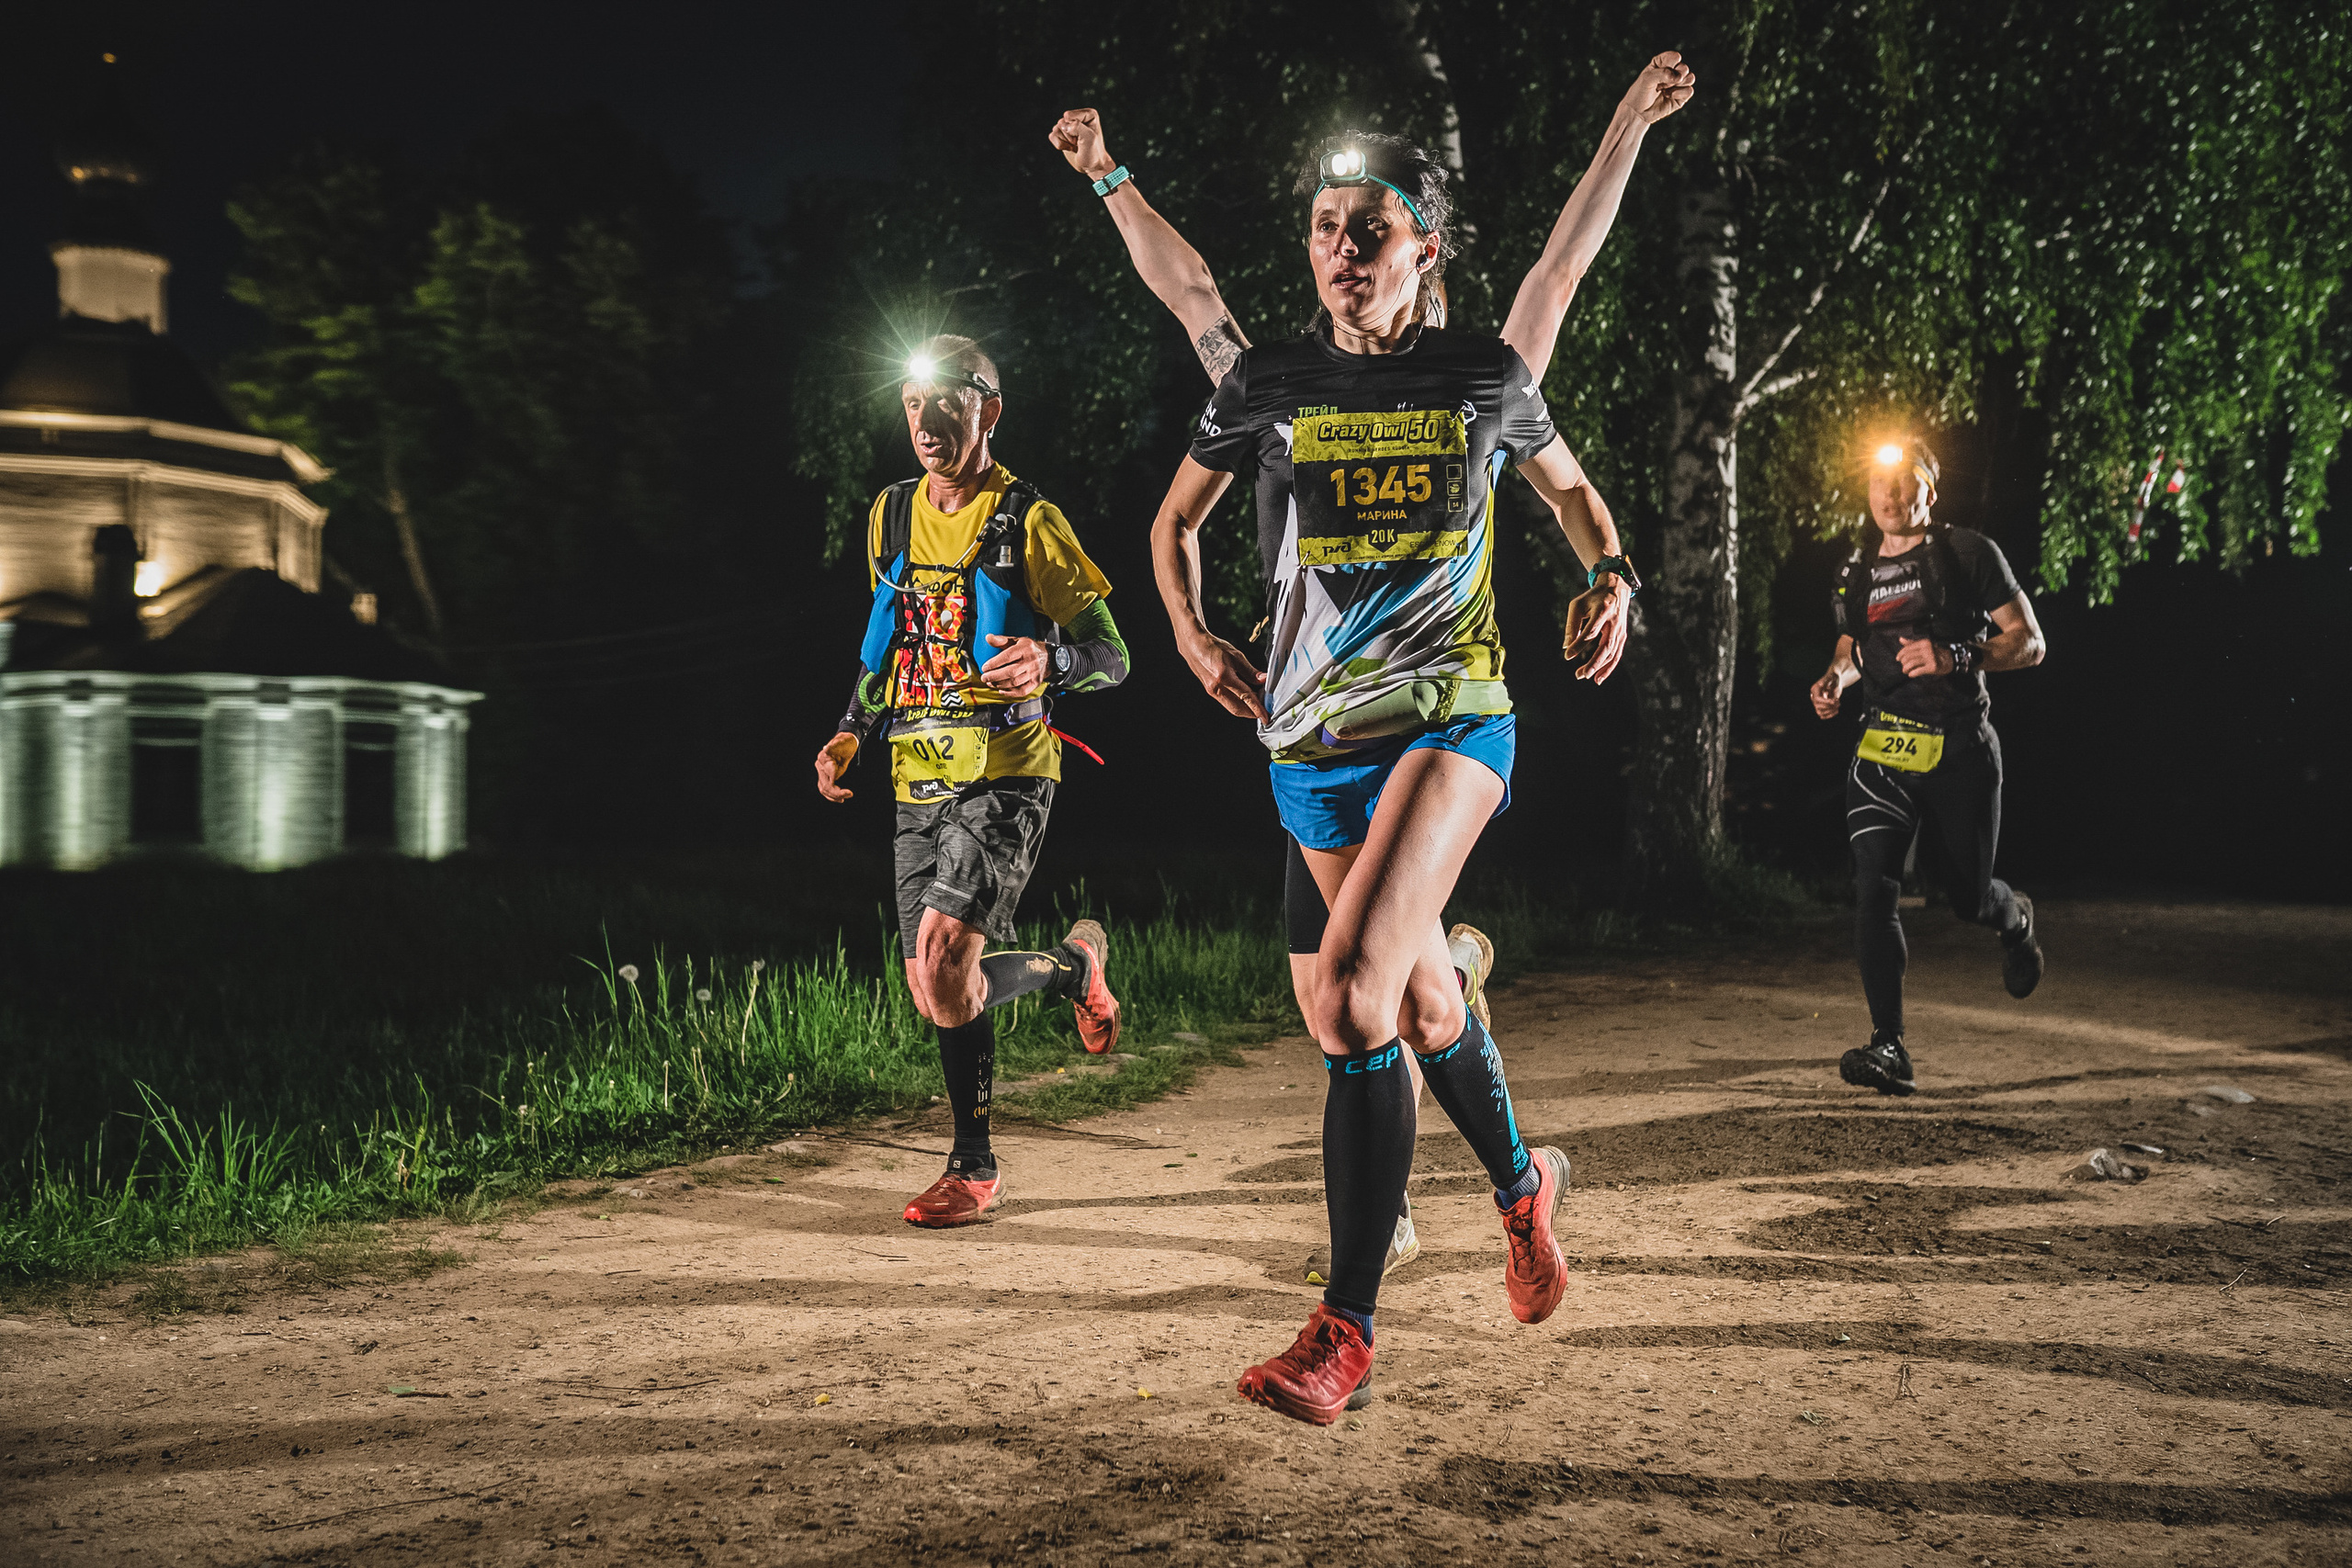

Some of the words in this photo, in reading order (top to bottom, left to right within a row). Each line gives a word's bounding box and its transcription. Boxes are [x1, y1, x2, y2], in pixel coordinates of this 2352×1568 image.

[1317, 422, 1369, 442] Crazy
[1371, 421, 1406, 441] Owl
[1407, 418, 1441, 442] 50
[1330, 464, 1432, 506] 1345
[1357, 510, 1408, 521] МАРИНА
[1372, 528, 1396, 543] 20K
[1409, 539, 1456, 548] ESENOW
[912, 735, 954, 761] 012
[1882, 737, 1917, 755] 294
